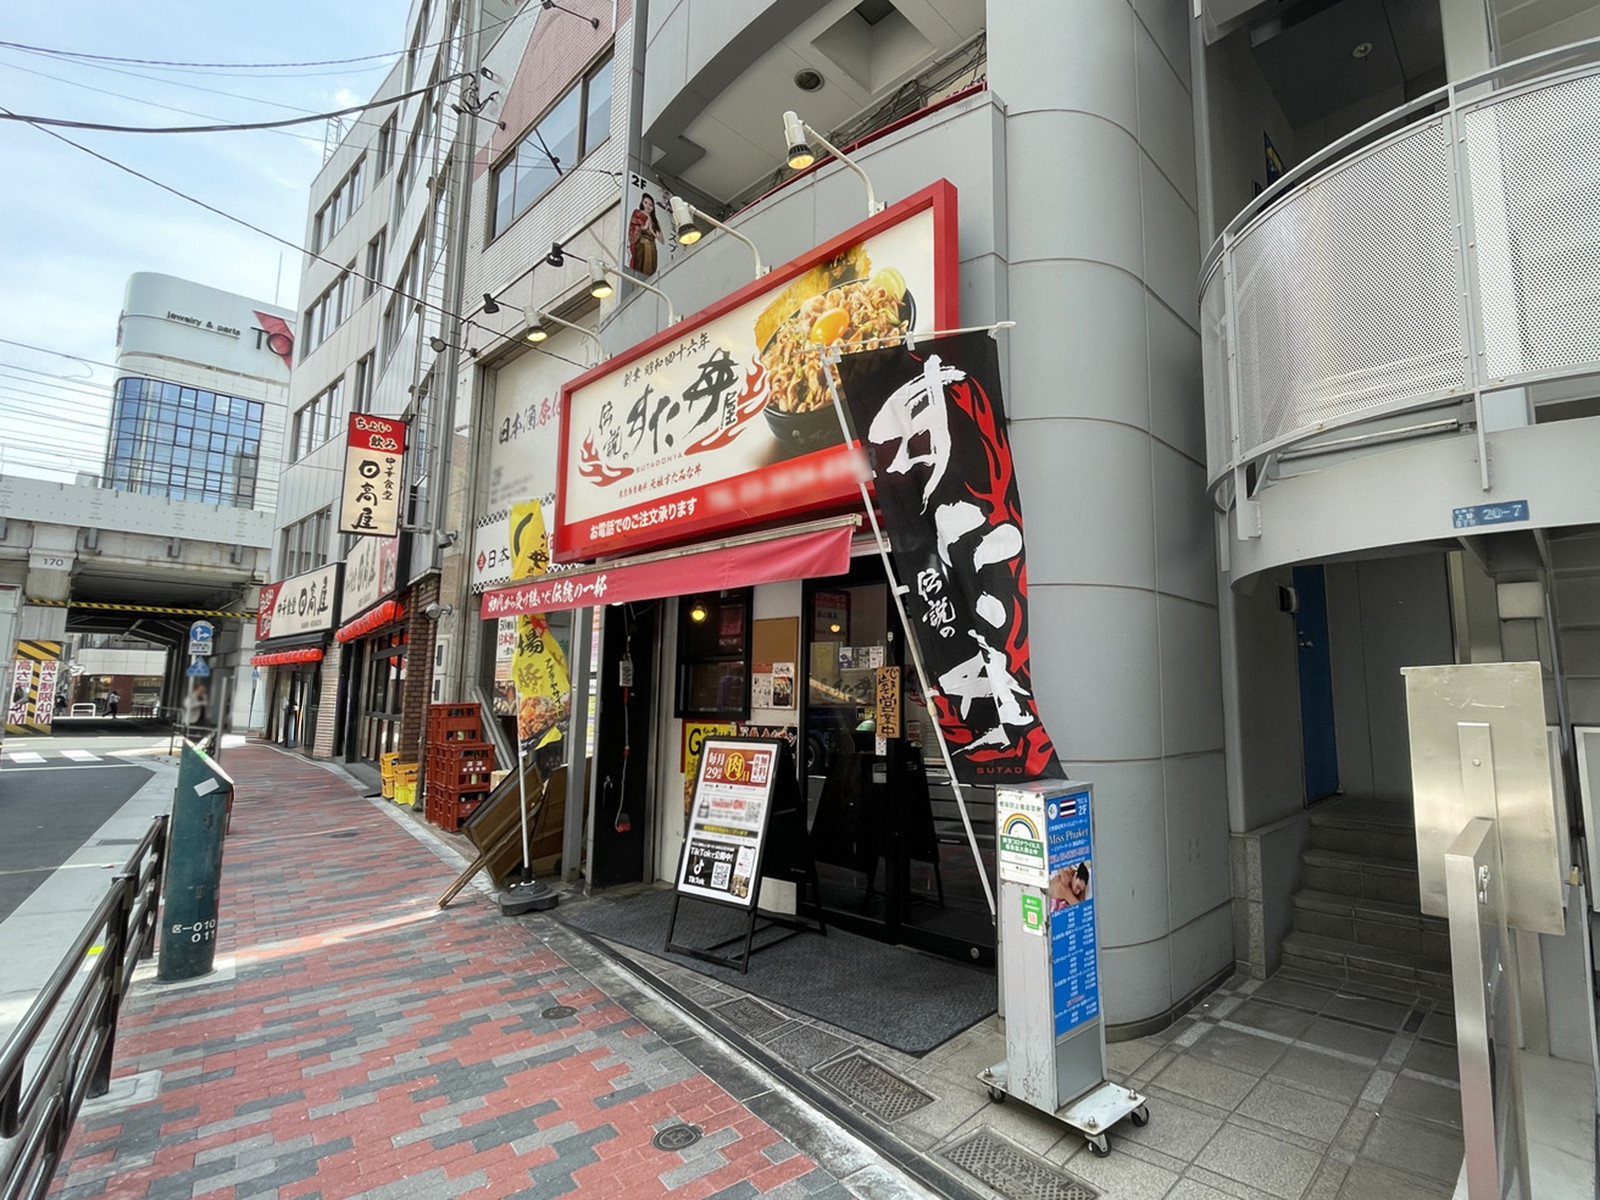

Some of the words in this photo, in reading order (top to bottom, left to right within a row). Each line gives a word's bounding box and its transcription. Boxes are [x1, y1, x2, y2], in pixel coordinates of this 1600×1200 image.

[632, 174, 647, 190] 2F
[167, 311, 202, 326] jewelry
[206, 321, 213, 329] &
[217, 325, 241, 337] parts
[644, 332, 711, 376] 昭和四十六年
[355, 418, 392, 433] ちょい
[369, 435, 398, 449] 飲み
[598, 400, 630, 461] 伝説の
[382, 457, 396, 501] 中華食堂
[635, 452, 684, 474] SUTADONYA
[351, 459, 380, 529] 日高屋
[589, 497, 698, 540] お電話でのご注文承ります
[1482, 504, 1522, 521] 20-7
[43, 558, 64, 567] 170
[298, 575, 329, 617] 日高屋
[916, 567, 955, 639] 伝説の
[879, 692, 898, 737] 営業中
[707, 751, 726, 766] 毎月
